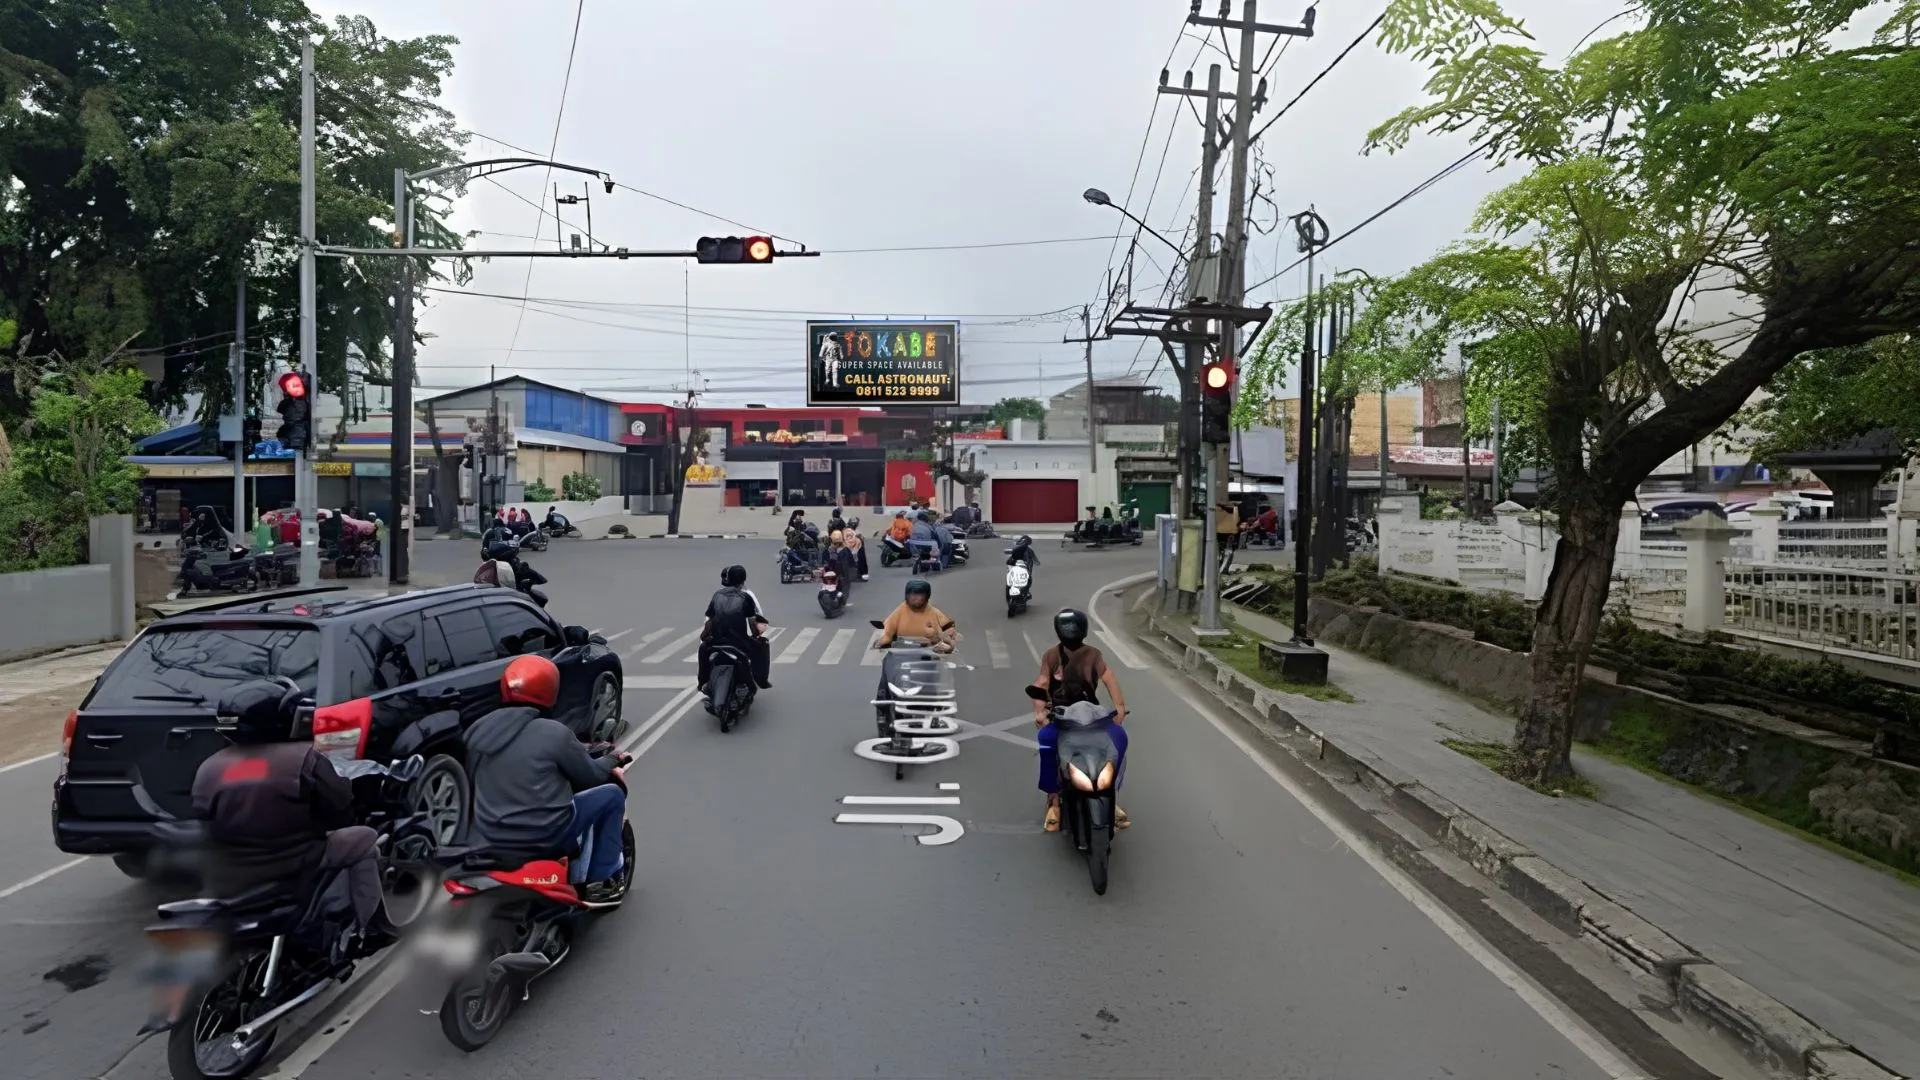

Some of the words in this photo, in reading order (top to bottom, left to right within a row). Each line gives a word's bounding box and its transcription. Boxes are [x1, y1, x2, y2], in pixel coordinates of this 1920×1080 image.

[844, 331, 936, 357] TOKABE
[837, 361, 863, 369] SUPER
[868, 361, 893, 369] SPACE
[897, 361, 943, 369] AVAILABLE
[844, 374, 874, 384] CALL
[877, 374, 951, 384] ASTRONAUT:
[856, 386, 881, 396] 0811
[885, 386, 906, 396] 523
[910, 386, 940, 396] 9999
